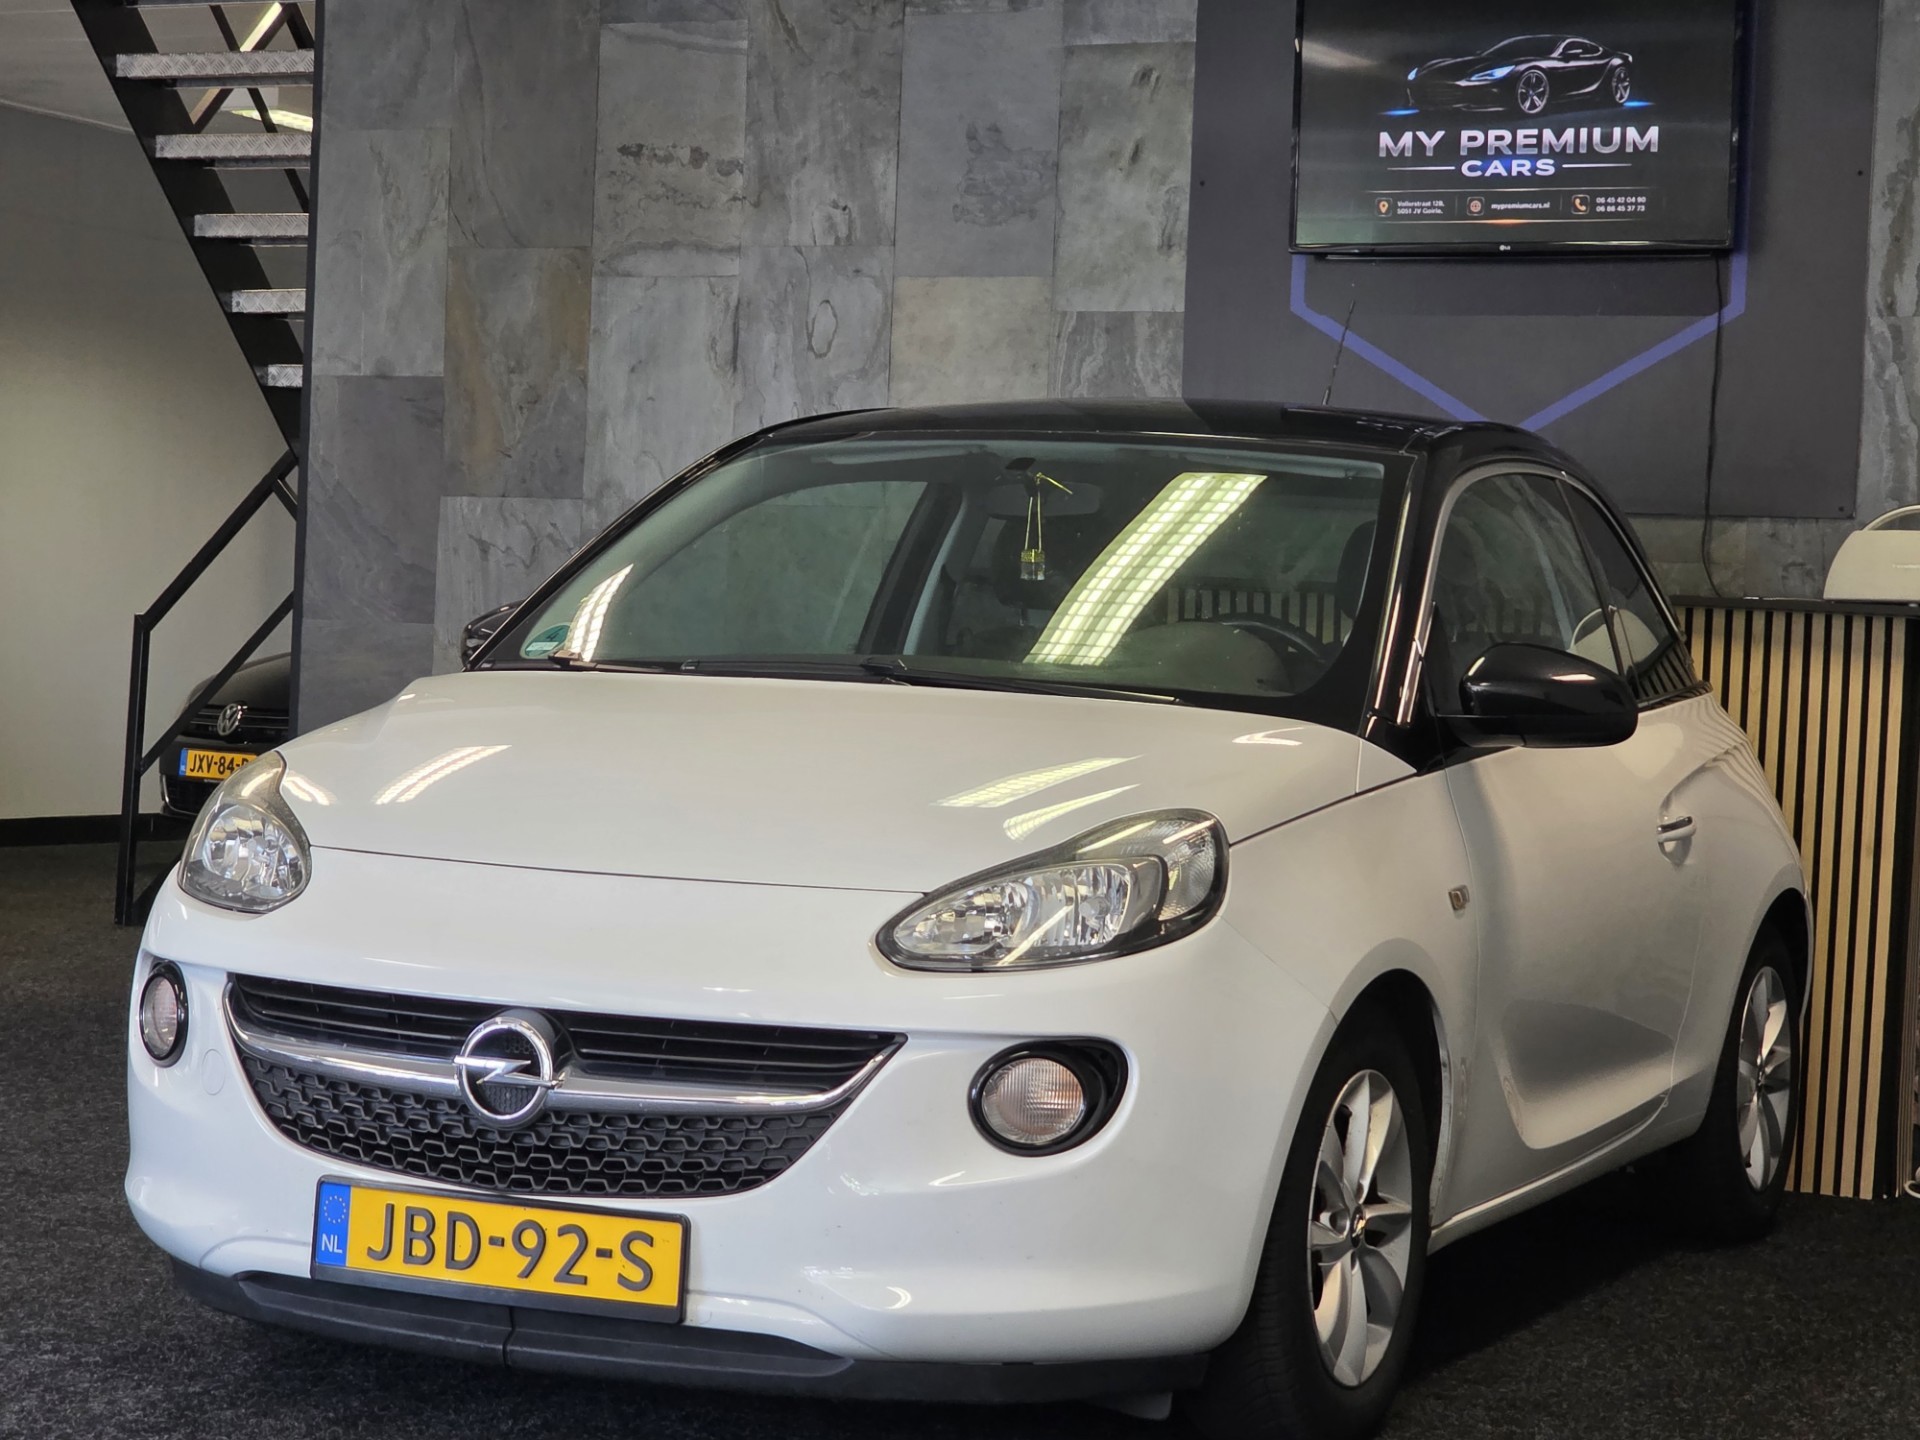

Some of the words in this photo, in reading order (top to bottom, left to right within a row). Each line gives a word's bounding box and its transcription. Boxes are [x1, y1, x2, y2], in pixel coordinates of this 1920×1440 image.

[1379, 130, 1446, 157] MY
[1460, 126, 1659, 156] PREMIUM
[1461, 158, 1556, 177] CARS
[1491, 201, 1550, 210] mypremiumcars.nl
[1595, 196, 1606, 204] 06
[321, 1234, 343, 1254] NL
[366, 1203, 655, 1292] JBD-92-S
